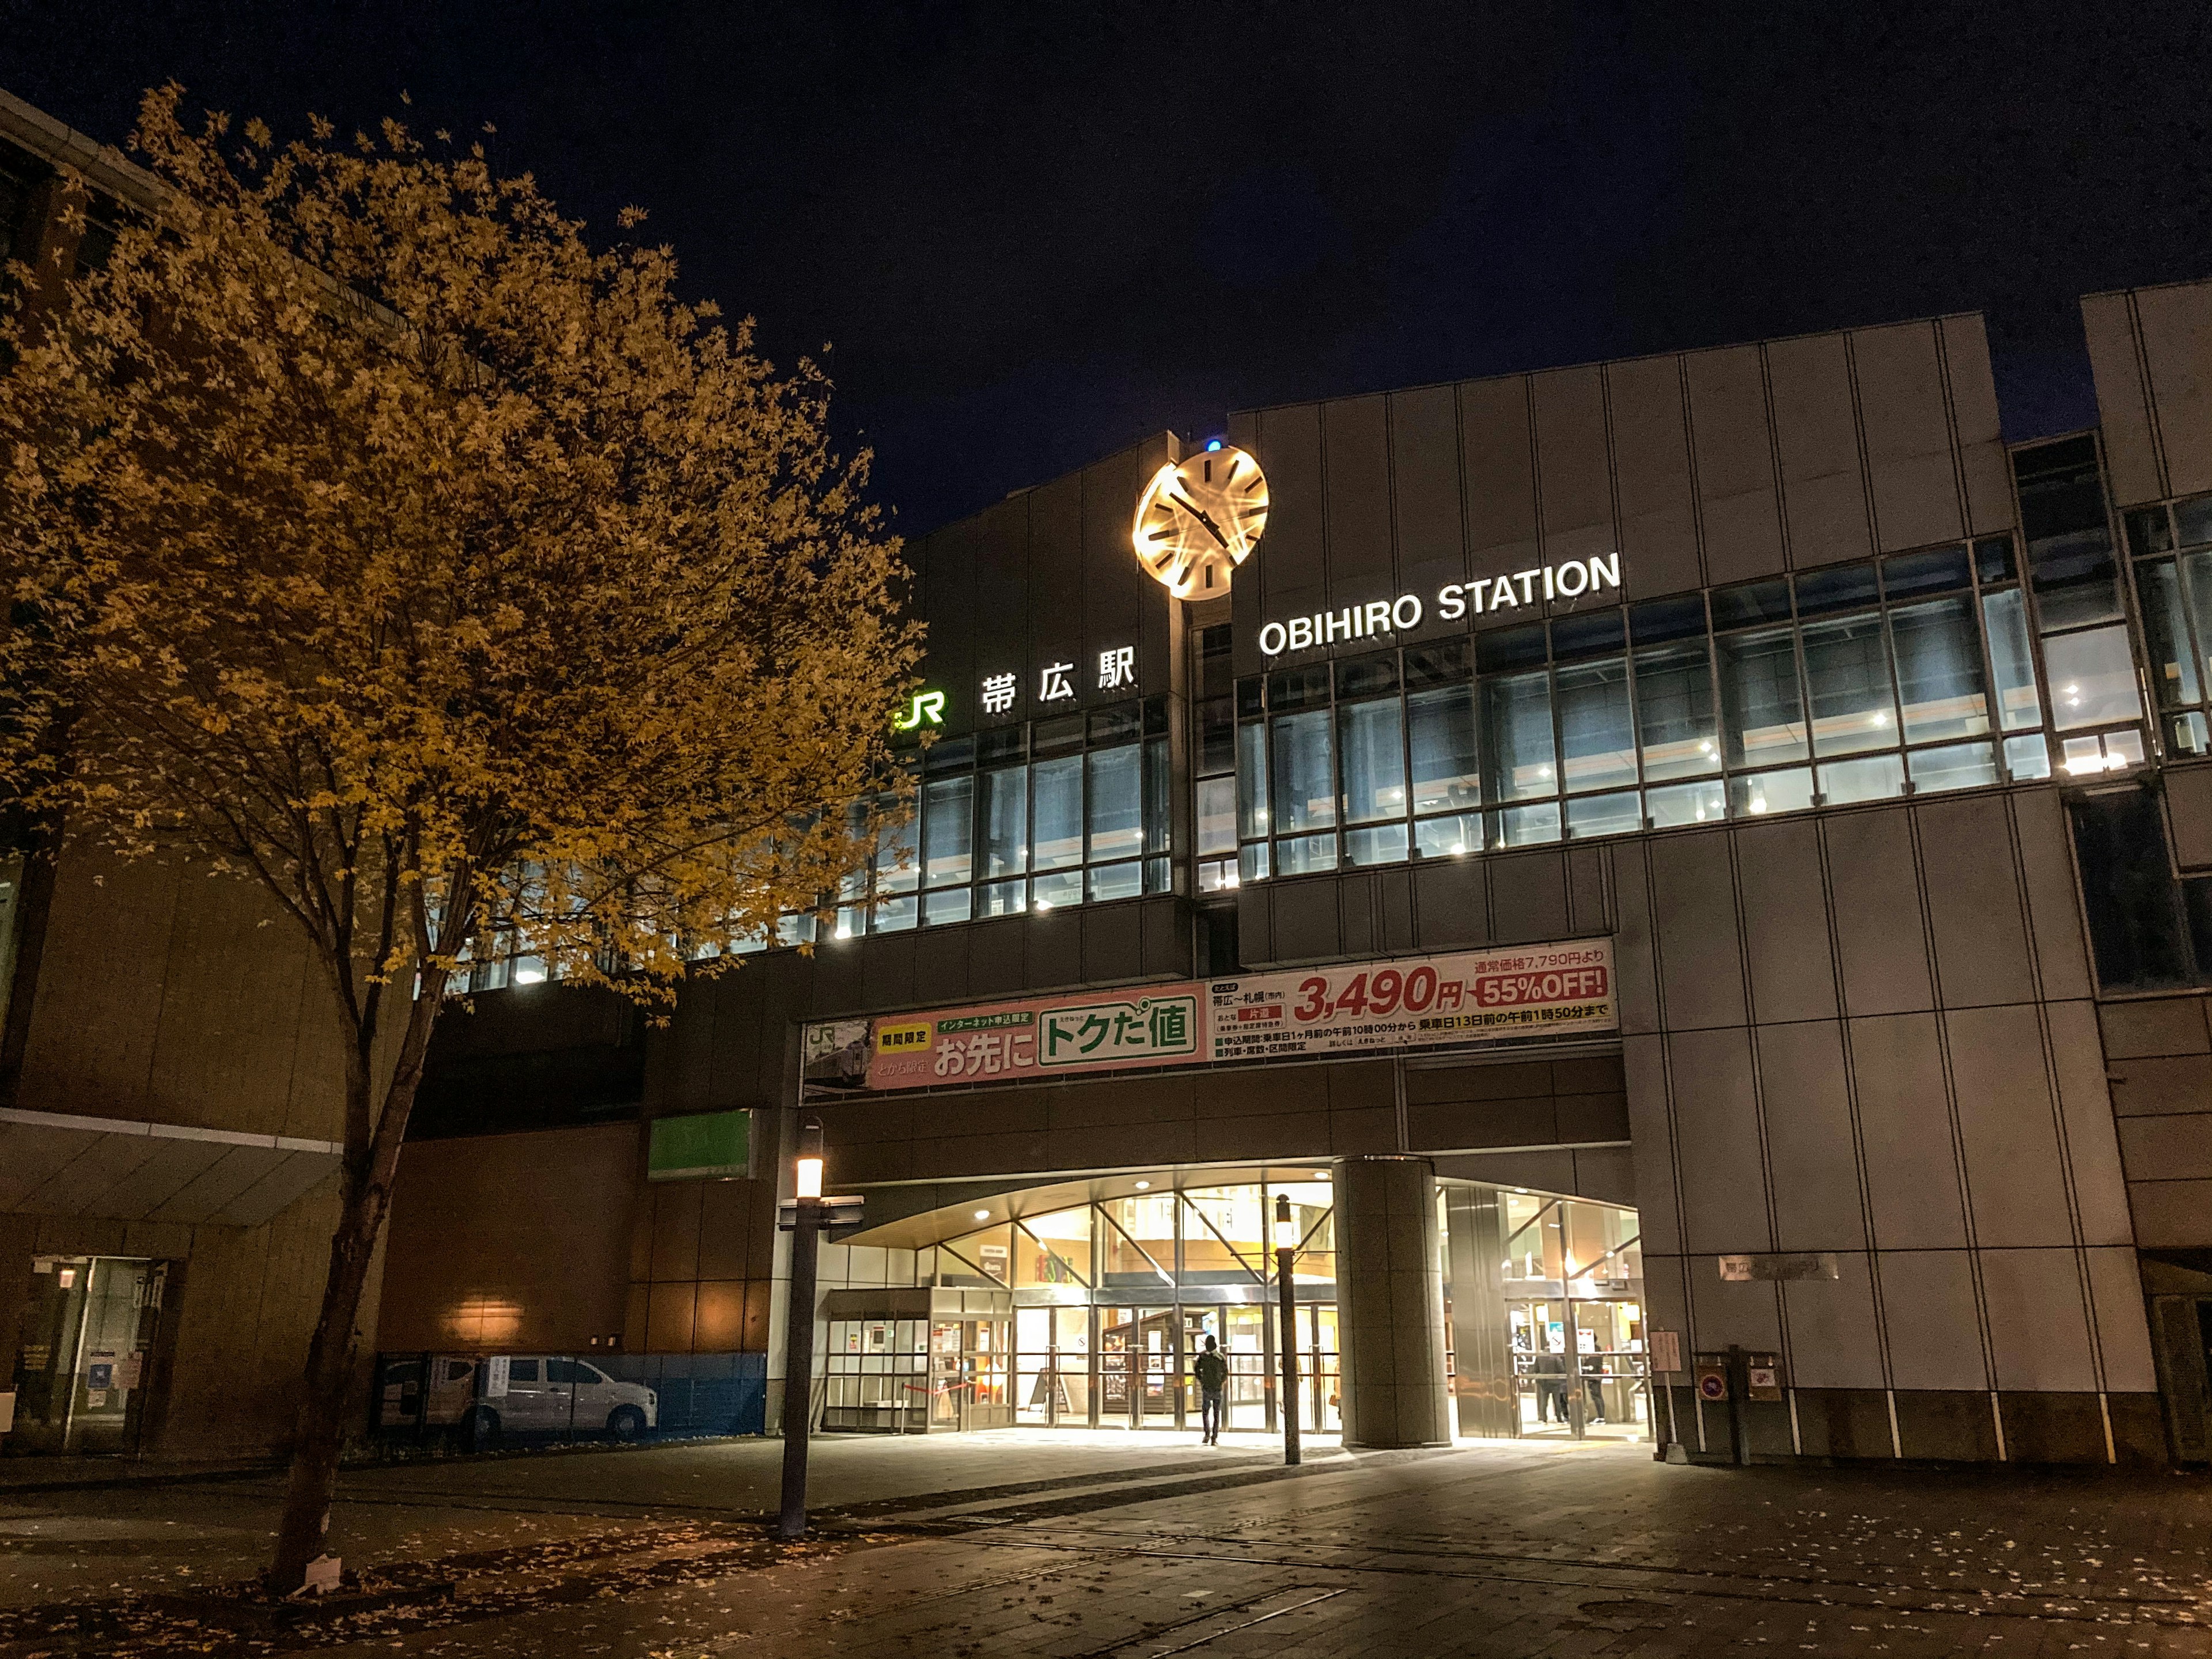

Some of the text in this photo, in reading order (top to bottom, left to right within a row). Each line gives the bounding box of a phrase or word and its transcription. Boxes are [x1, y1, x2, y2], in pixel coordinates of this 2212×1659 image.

[1259, 552, 1620, 656] OBIHIRO STATION
[983, 646, 1134, 713] 帯広駅
[894, 691, 944, 729] JR
[1475, 950, 1604, 974] 通常価格7,790円より
[1294, 966, 1463, 1021] 3,490円
[1484, 969, 1603, 1003] 55%OFF!
[809, 1027, 835, 1044] JR
[941, 1012, 1029, 1030] インターネット申込限定
[882, 1031, 926, 1047] 期間限定
[934, 1033, 1034, 1077] お先に
[877, 1059, 929, 1077] とかち限定
